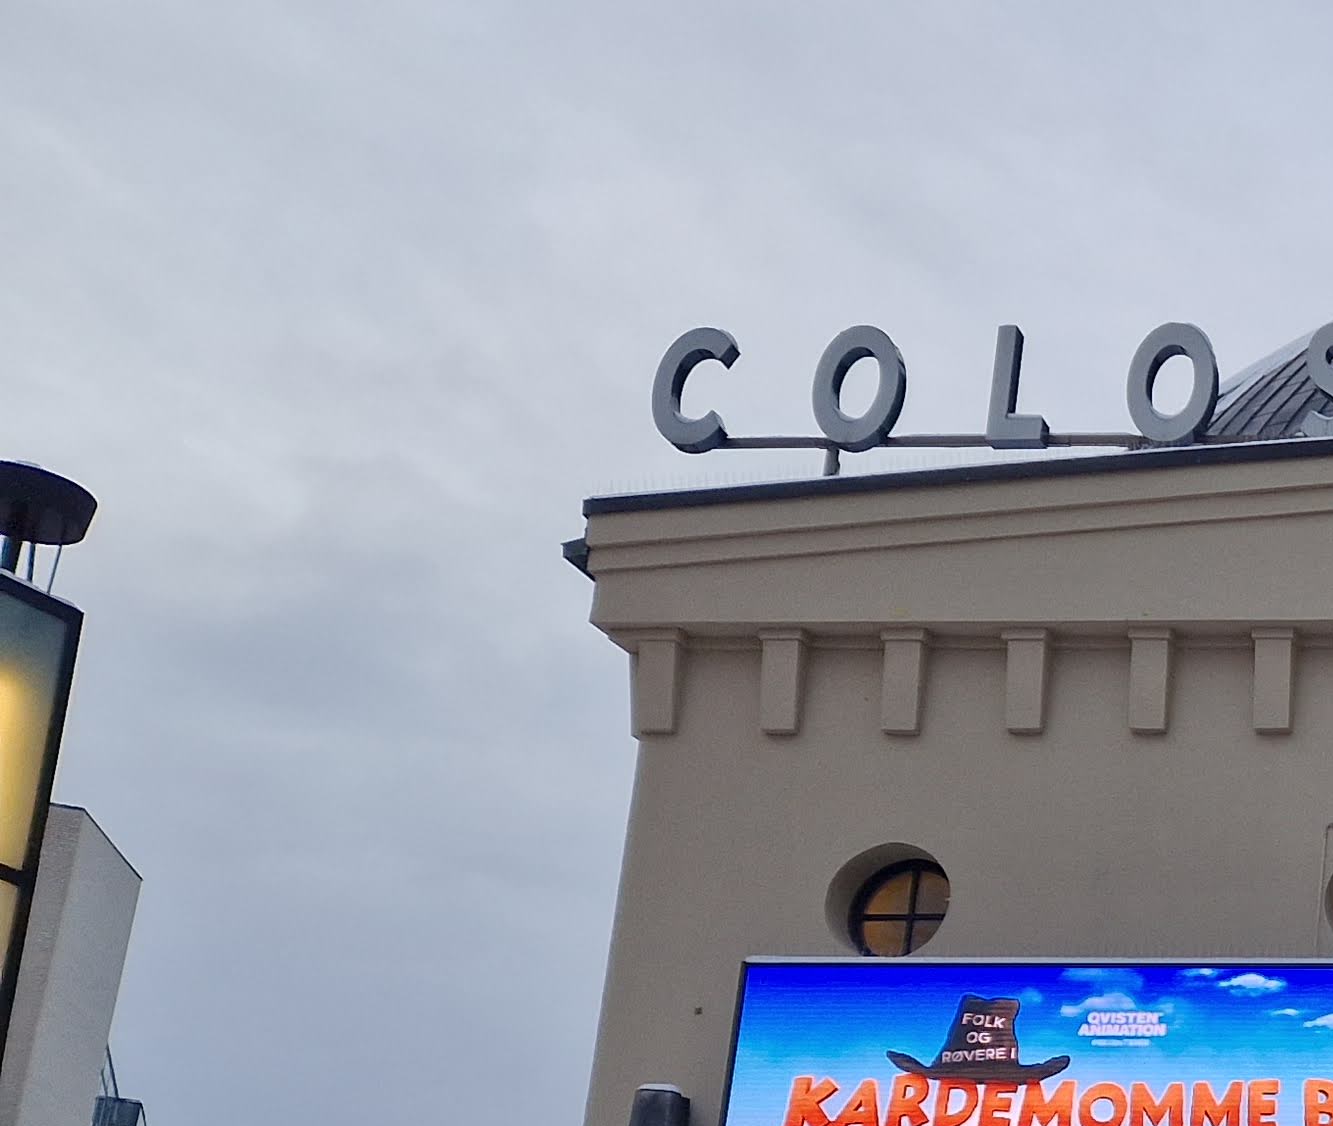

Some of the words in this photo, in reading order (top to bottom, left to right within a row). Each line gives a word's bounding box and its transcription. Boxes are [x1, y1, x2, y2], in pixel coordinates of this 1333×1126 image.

[961, 1012, 1006, 1028] FOLK
[1087, 1011, 1160, 1025] QVISTEN
[1077, 1023, 1168, 1037] ANIMATION
[966, 1031, 992, 1044] OG
[941, 1047, 1007, 1064] RØVERE
[1010, 1047, 1017, 1059] I
